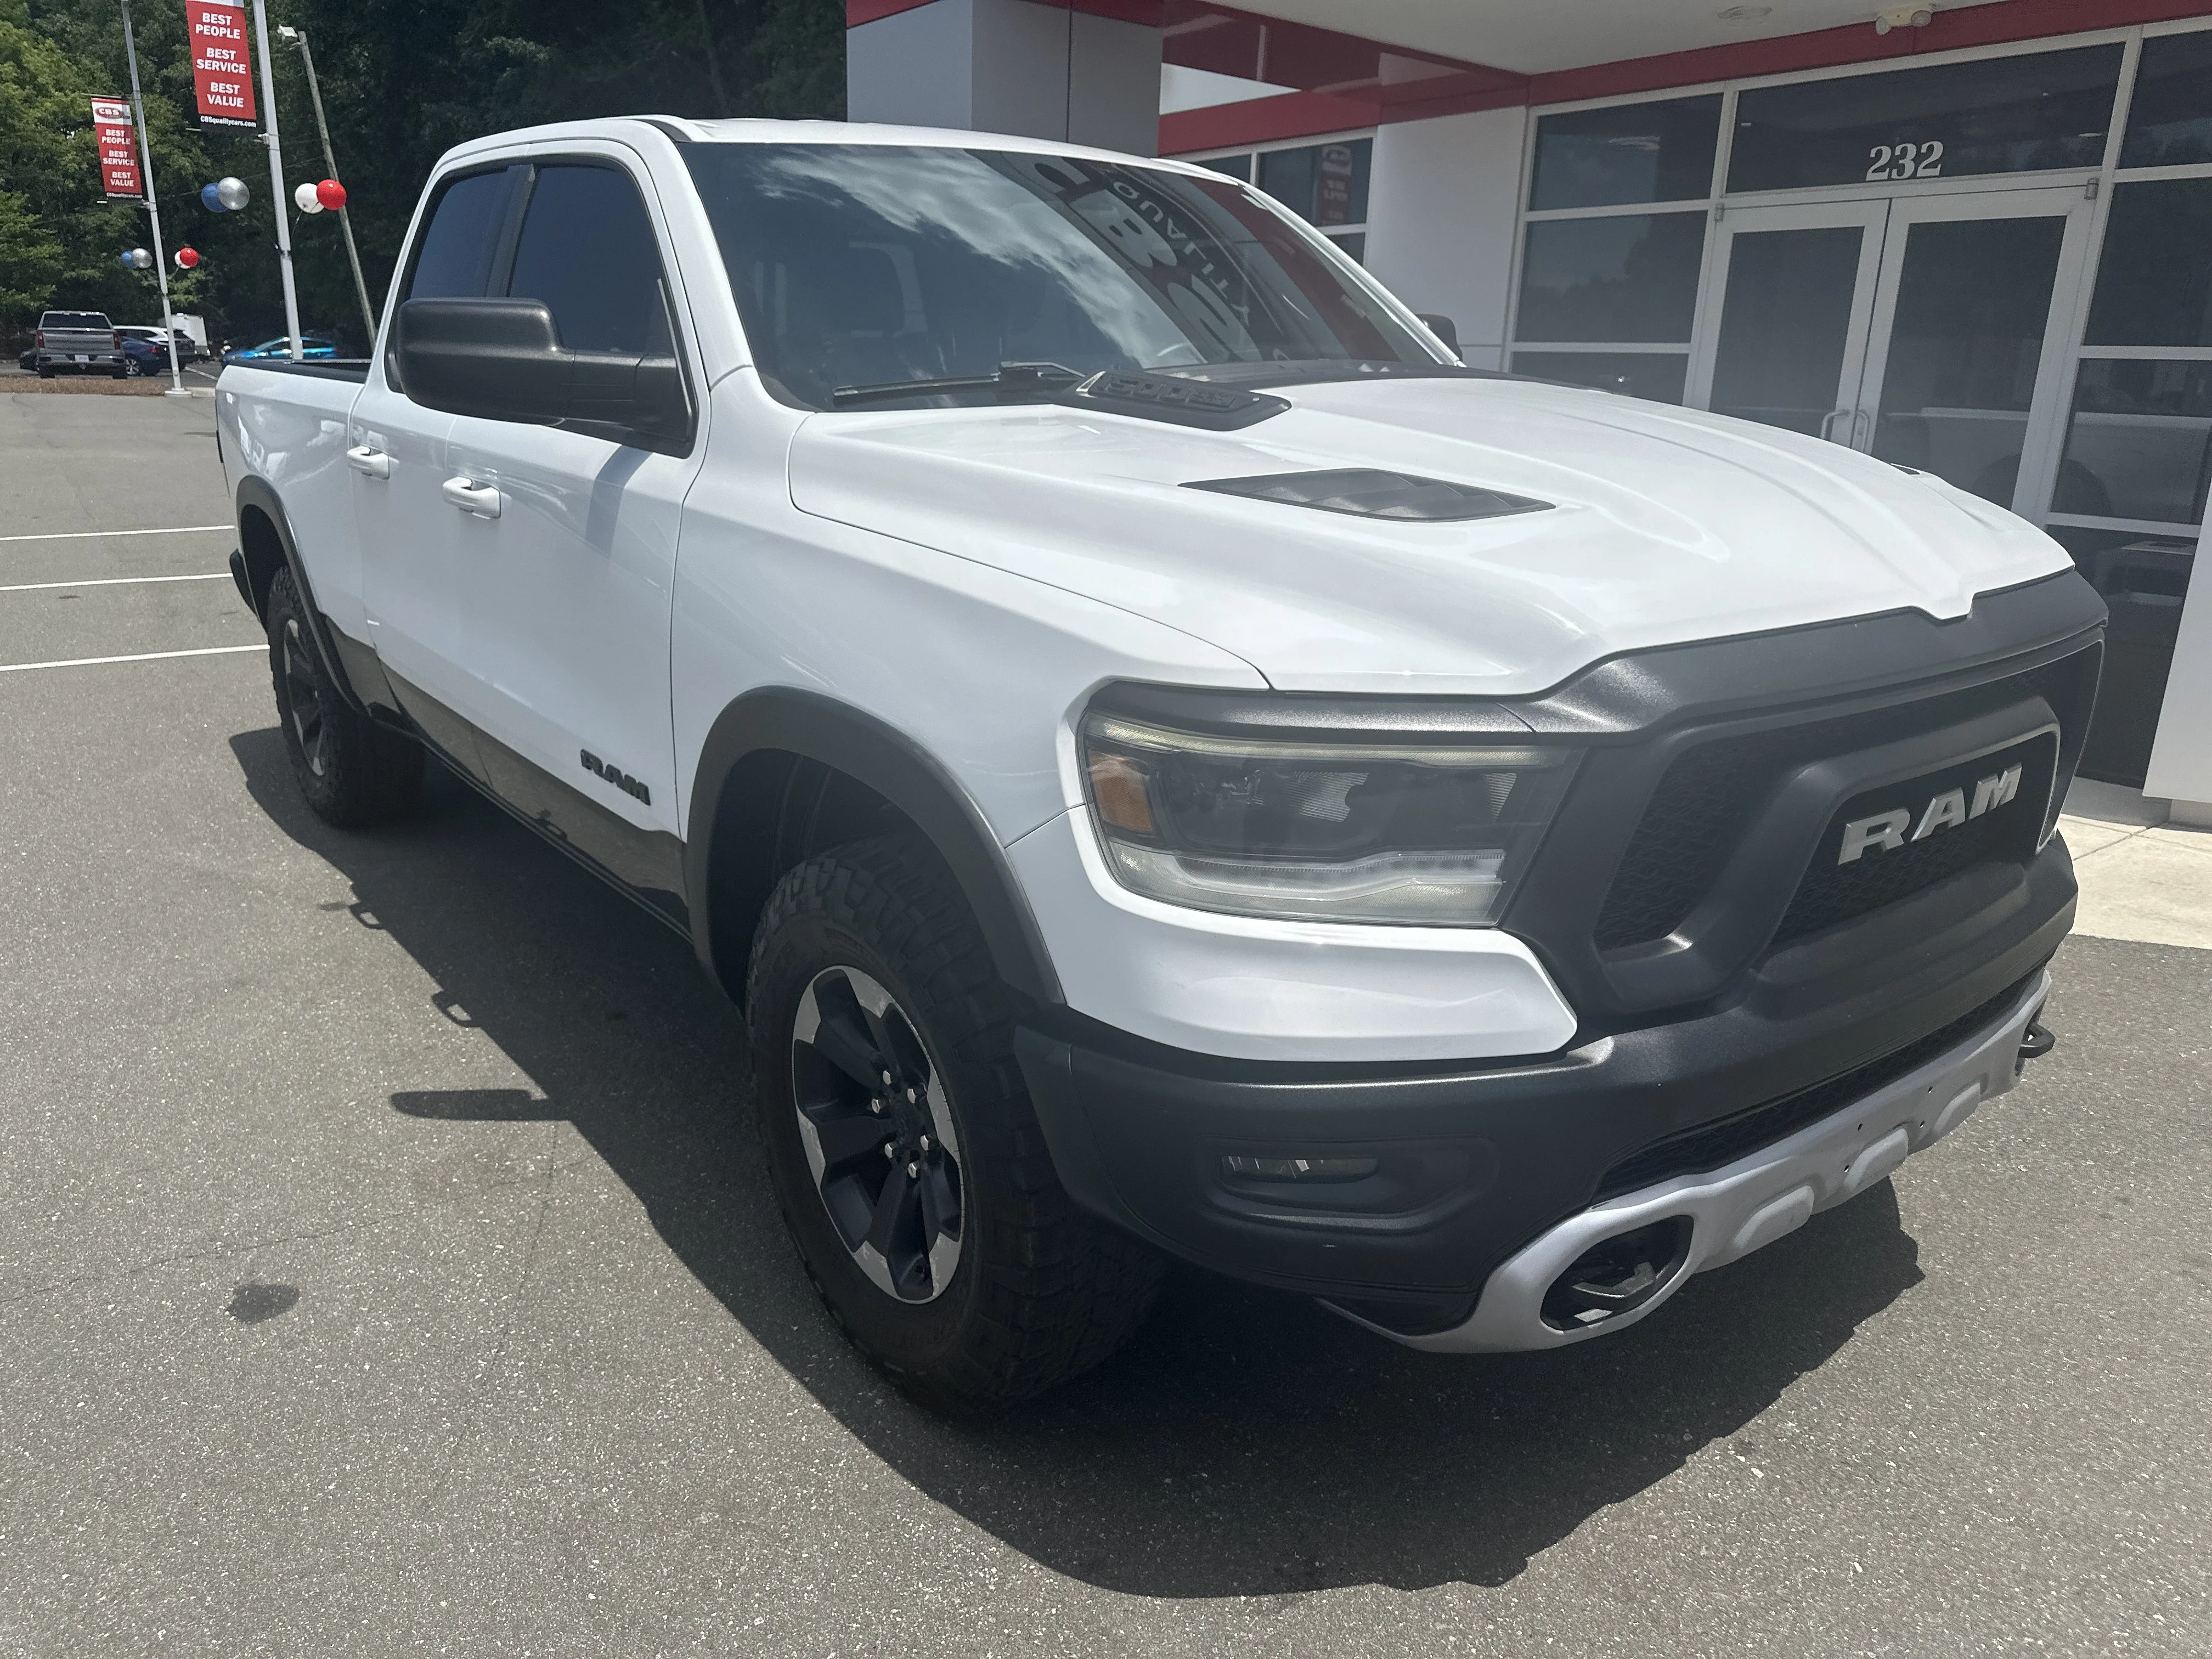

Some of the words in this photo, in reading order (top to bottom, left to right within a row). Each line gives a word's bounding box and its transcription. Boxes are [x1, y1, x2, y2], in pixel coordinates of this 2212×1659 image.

[202, 12, 233, 26] BEST
[195, 24, 241, 40] PEOPLE
[206, 47, 236, 60] BEST
[196, 58, 246, 74] SERVICE
[210, 82, 240, 94] BEST
[207, 94, 244, 108] VALUE
[200, 115, 257, 128] CBSqualitycars.com
[105, 128, 125, 137] BEST
[101, 136, 131, 145] PEOPLE
[109, 150, 128, 158] BEST
[103, 157, 135, 166] SERVICE
[1865, 140, 1944, 182] 232
[112, 171, 132, 179] BEST
[110, 178, 134, 187] VALUE
[580, 748, 651, 806] RAM
[1838, 761, 2023, 866] RAM
